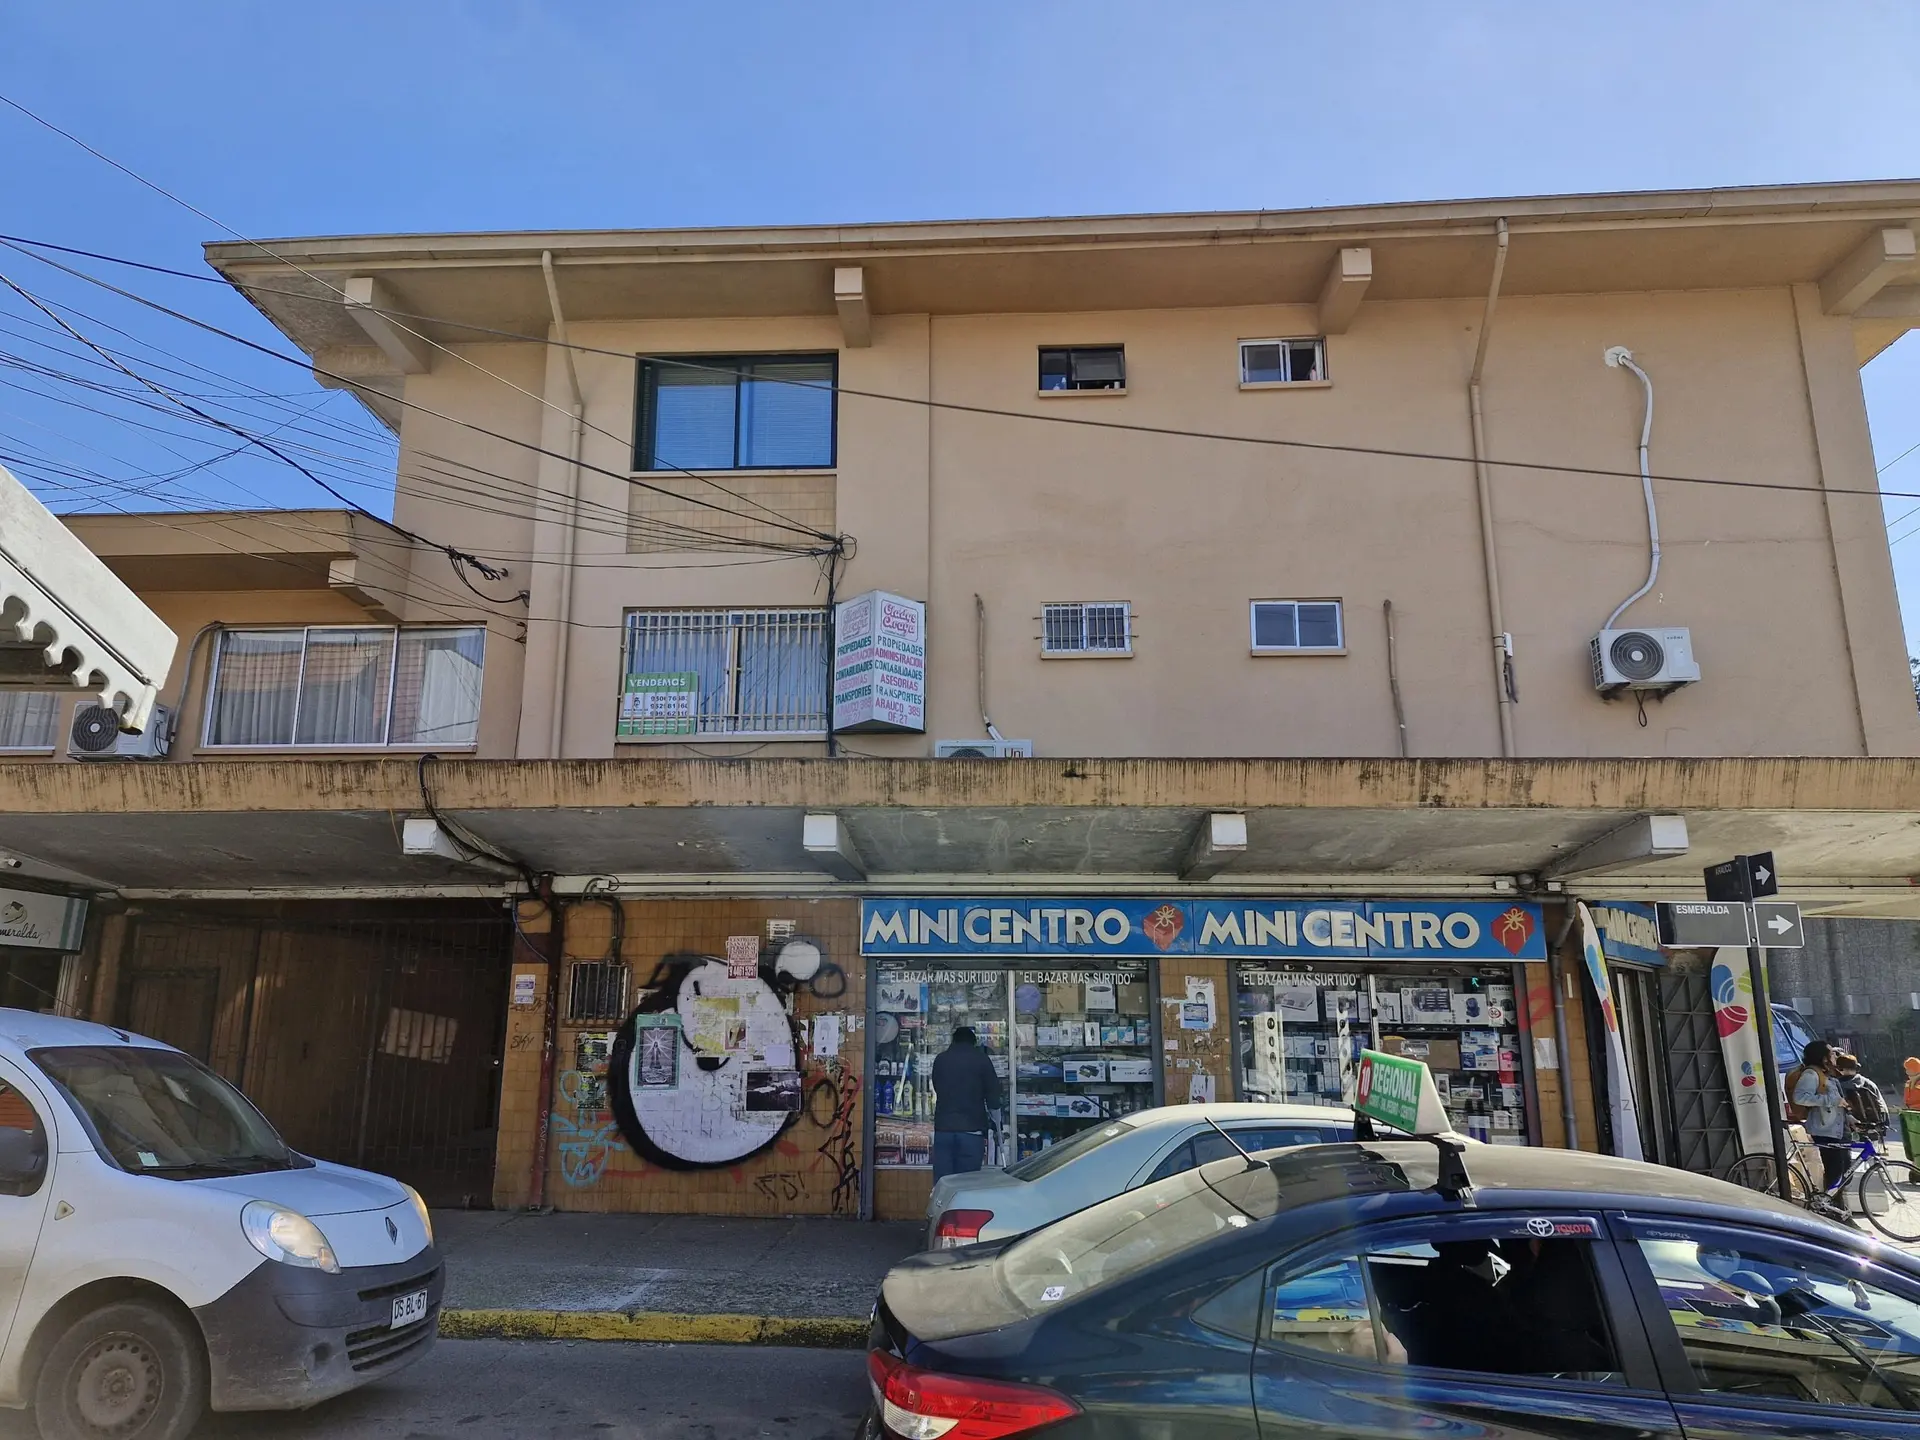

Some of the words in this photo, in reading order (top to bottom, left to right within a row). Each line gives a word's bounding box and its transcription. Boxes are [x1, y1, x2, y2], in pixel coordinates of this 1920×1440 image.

[837, 636, 871, 657] PROPIEDADES
[878, 636, 923, 657] PROPIEDADES
[875, 647, 923, 669] ADMINISTRACION
[836, 660, 873, 681] CONTABILIDADES
[875, 660, 922, 680] CONTABILIDADES
[630, 678, 686, 687] VENDEMOS
[881, 673, 918, 691] ASESORIAS
[835, 685, 871, 705] TRANSPORTES
[875, 697, 903, 712] ARAUCO
[876, 684, 922, 705] TRANSPORTES
[1715, 863, 1732, 876] ARAUCO
[1676, 905, 1730, 915] ESMERALDA
[864, 908, 959, 944] MINI
[963, 908, 1131, 944] CENTRO
[1198, 909, 1298, 946] MINI
[1302, 909, 1481, 949] CENTRO
[903, 971, 934, 983] BAZAR
[936, 971, 956, 983] MAS
[1038, 972, 1069, 984] BAZAR
[1071, 972, 1090, 984] MAS
[1257, 973, 1290, 986] BAZAR
[1292, 974, 1312, 986] MAS
[1361, 1067, 1371, 1097] 10
[1371, 1062, 1418, 1105] REGIONAL
[1554, 1224, 1592, 1233] TOYOTA
